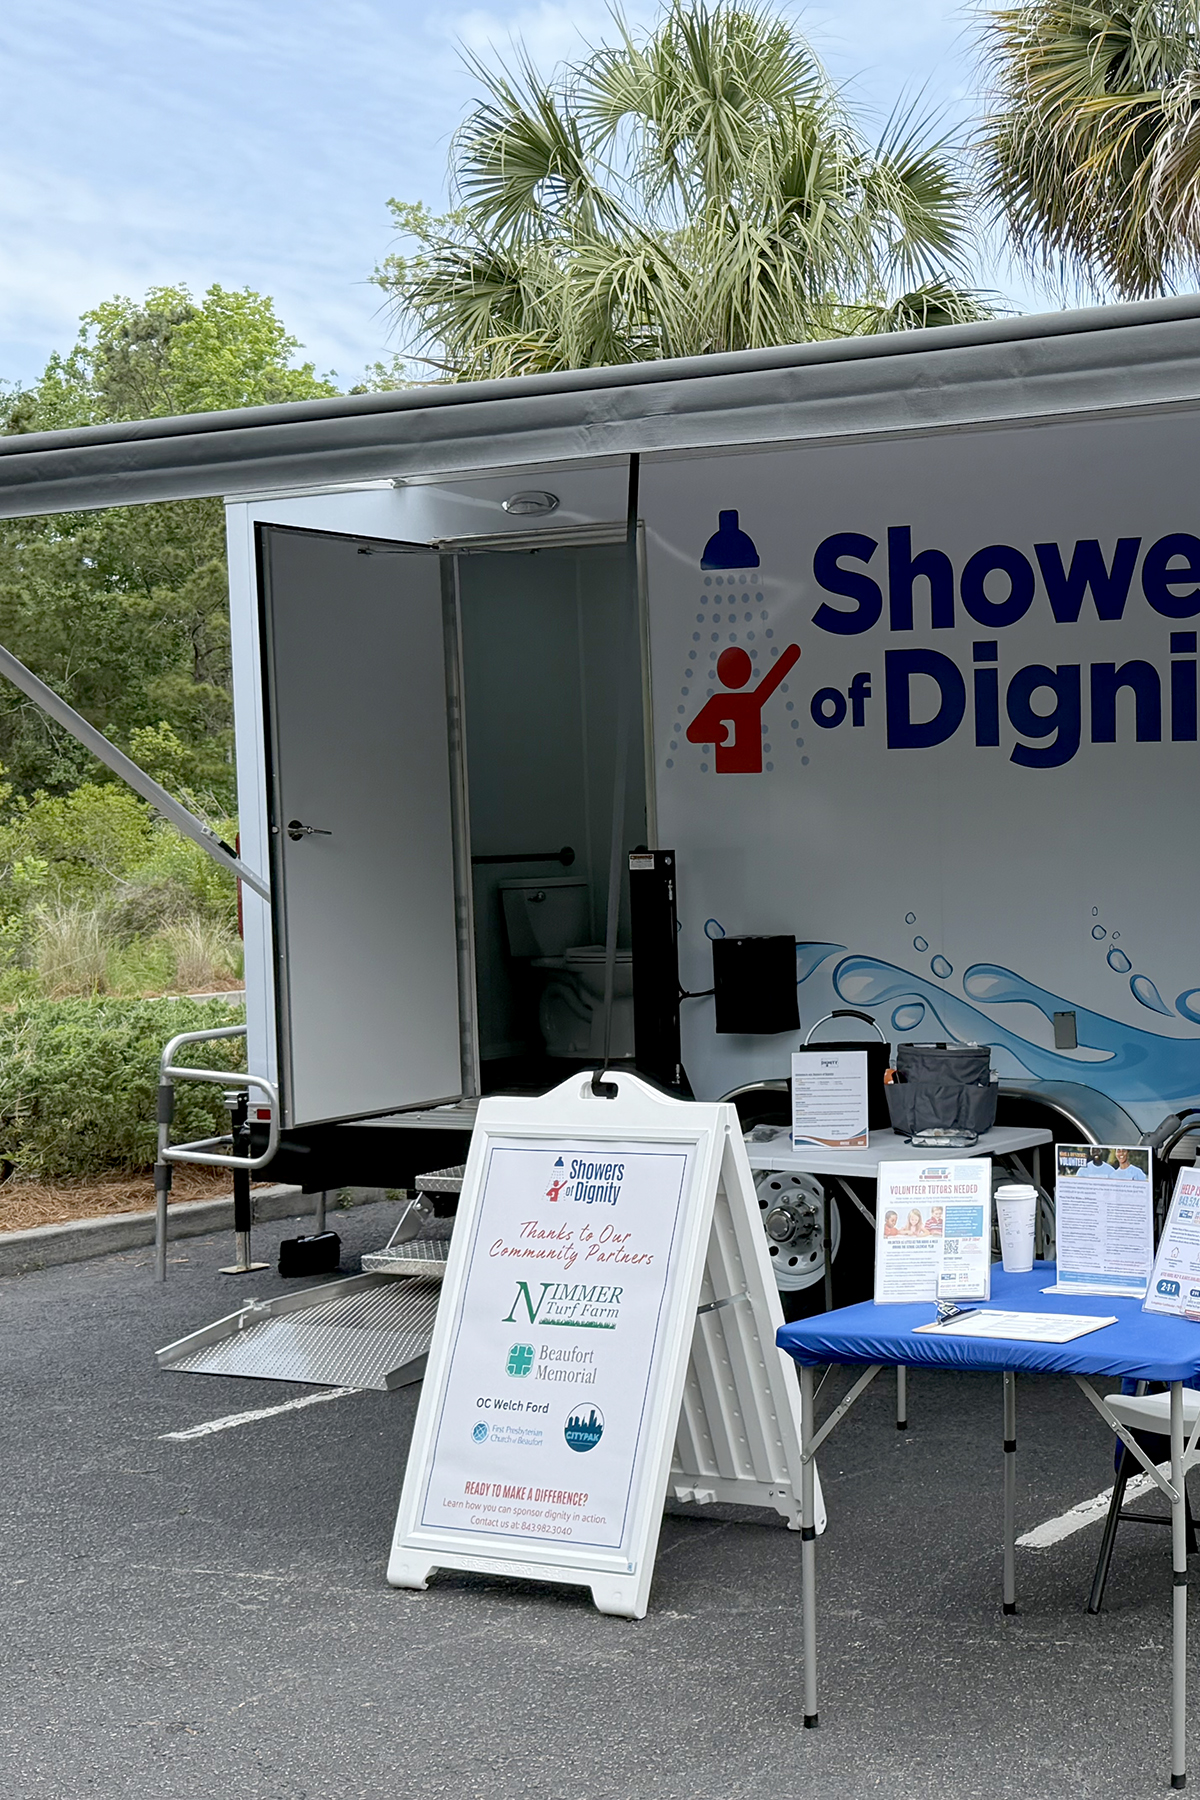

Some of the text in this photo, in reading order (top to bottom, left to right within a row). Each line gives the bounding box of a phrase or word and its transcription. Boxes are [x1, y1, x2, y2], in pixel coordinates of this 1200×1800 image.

[810, 672, 872, 729] of
[569, 1159, 625, 1182] Showers
[566, 1181, 621, 1206] of Dignity
[890, 1183, 979, 1196] VOLUNTEER TUTORS NEEDED
[1181, 1183, 1196, 1196] HELP
[520, 1221, 632, 1244] Thanks to Our
[488, 1239, 654, 1270] Community Partners
[501, 1281, 624, 1325] NIMMER
[546, 1301, 620, 1318] Turf Farm
[538, 1344, 595, 1363] Beaufort
[535, 1365, 597, 1385] Memorial
[476, 1397, 549, 1413] OC Welch Ford
[490, 1433, 511, 1443] Church
[517, 1436, 543, 1446] Beaufort
[492, 1424, 543, 1437] First Presbyterian
[565, 1431, 600, 1441] CITYPAK
[464, 1480, 589, 1507] READY TO MAKE A DIFFERENCE?
[442, 1497, 607, 1525] Learn how you can sponsor dignity in action.
[470, 1515, 499, 1527] Contact
[500, 1520, 509, 1529] us
